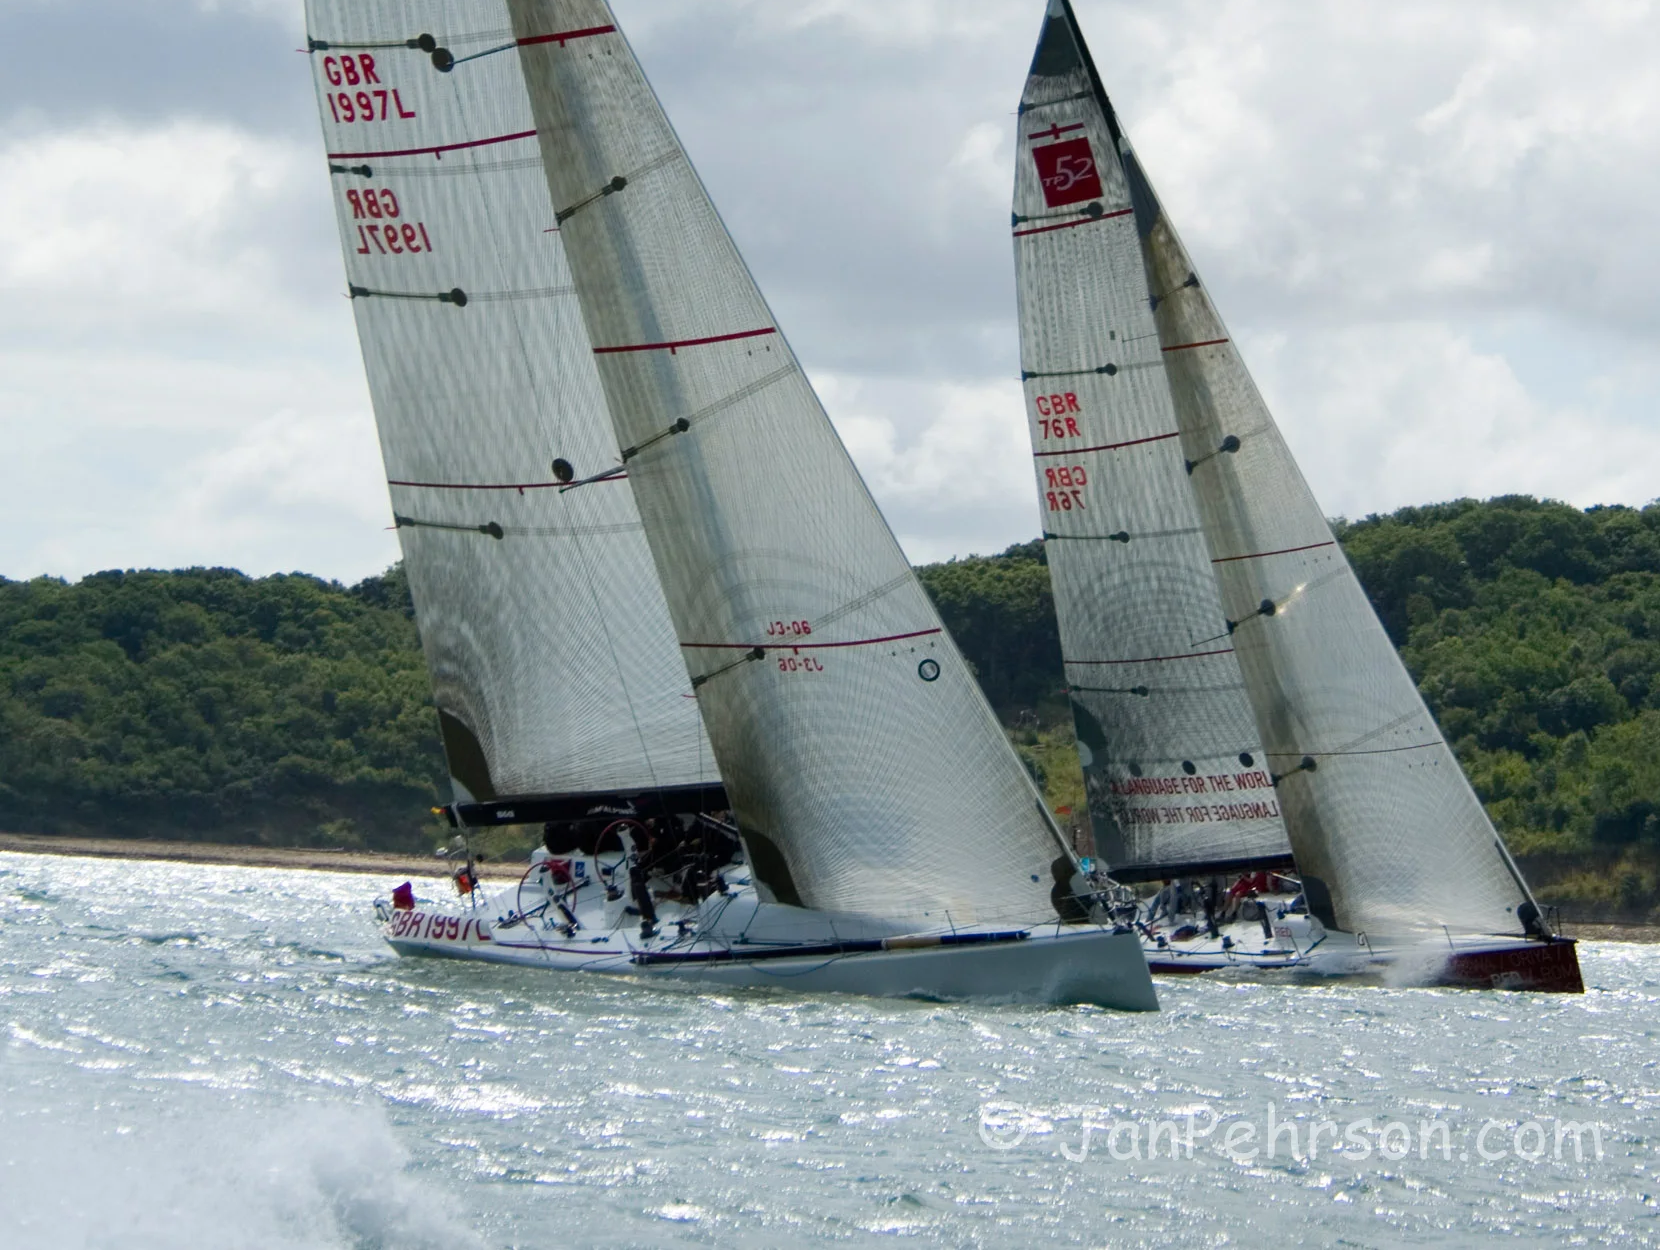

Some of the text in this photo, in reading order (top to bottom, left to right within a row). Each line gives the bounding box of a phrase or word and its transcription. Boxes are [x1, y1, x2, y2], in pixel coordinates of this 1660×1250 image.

[323, 53, 381, 86] GBR
[327, 89, 416, 123] 1997L
[1036, 392, 1081, 416] GBR
[1038, 417, 1081, 439] 76R
[1124, 776, 1182, 795] LANGUAGE
[1181, 776, 1208, 793] FOR
[1207, 774, 1234, 792] THE
[1233, 770, 1273, 790] WORL
